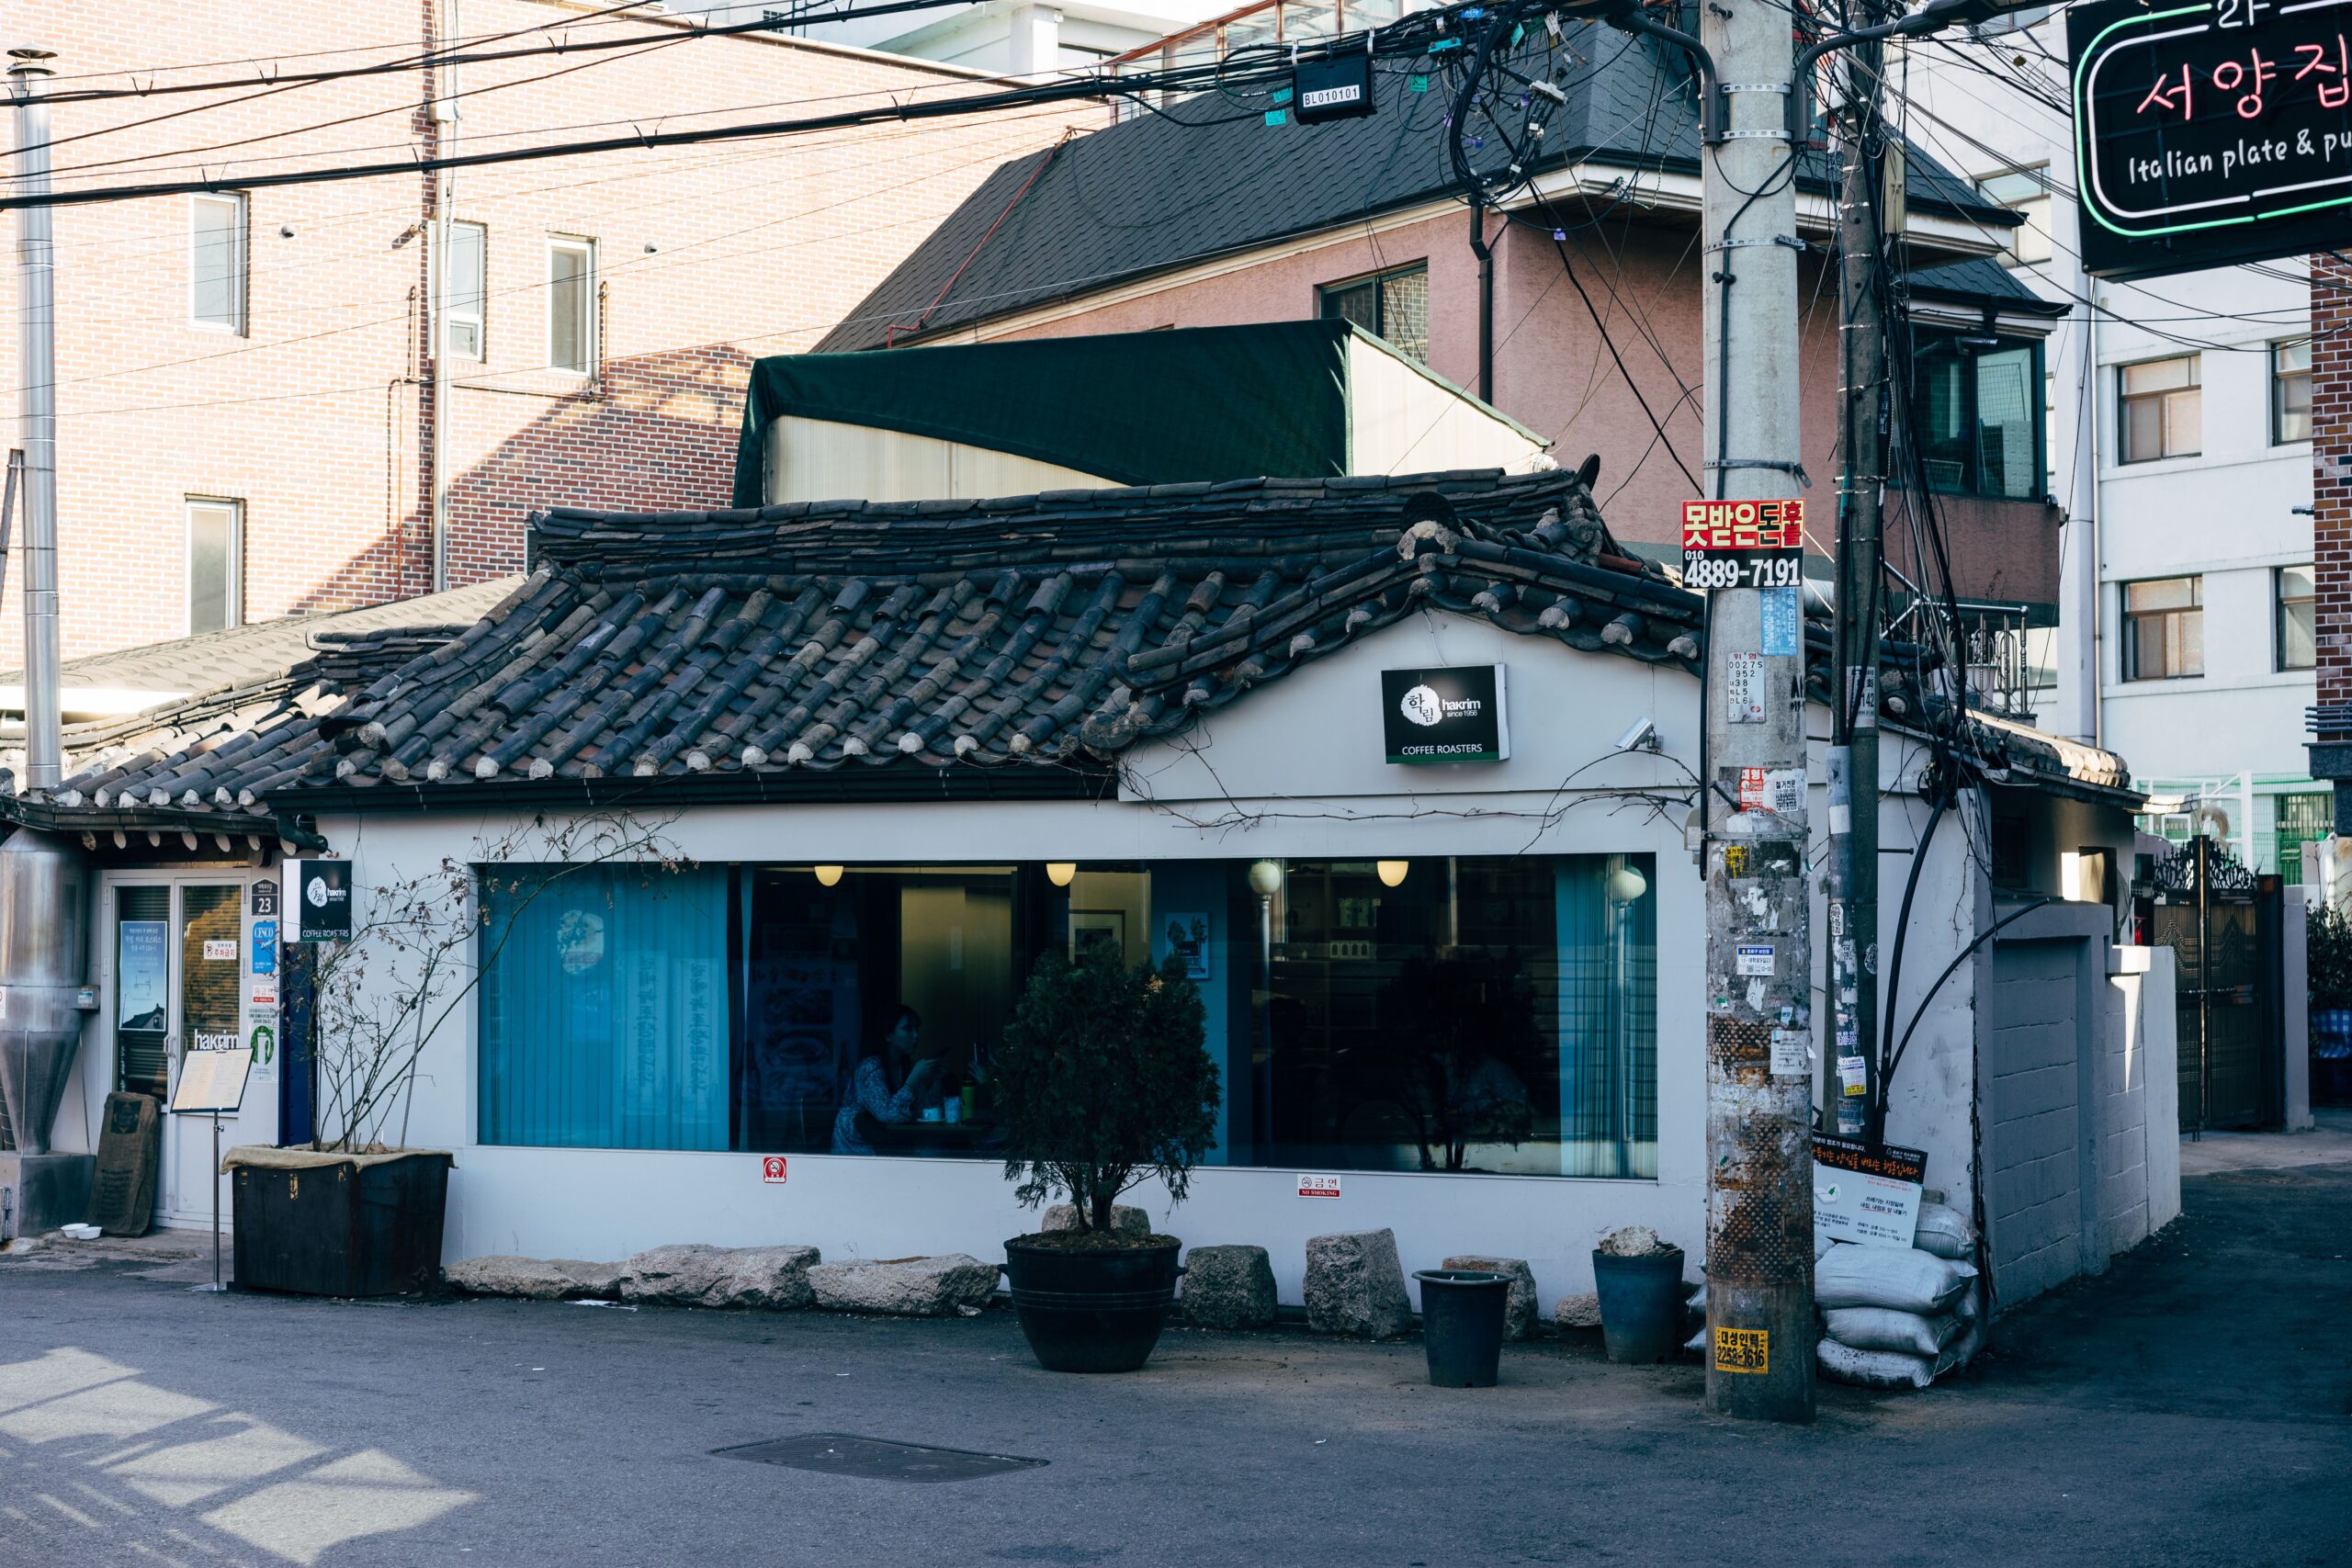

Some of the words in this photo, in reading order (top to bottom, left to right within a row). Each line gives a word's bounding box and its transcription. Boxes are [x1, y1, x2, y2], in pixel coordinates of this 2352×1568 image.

[2136, 33, 2349, 121] 서양집
[1305, 87, 1358, 105] BL010101
[2130, 151, 2212, 184] Italian
[2222, 139, 2288, 179] plate
[2296, 128, 2315, 154] &
[1685, 549, 1704, 560] 010
[1684, 558, 1800, 588] 4889-7191
[1736, 670, 1756, 678] 952
[1408, 694, 1434, 722] 학림
[1442, 698, 1481, 711] hakrim
[1402, 745, 1435, 755] COFFEE
[1437, 743, 1483, 754] ROASTERS
[327, 887, 346, 897] hakrim
[258, 897, 271, 913] 23
[254, 927, 274, 939] CESCO
[302, 930, 322, 938] COFFEE
[323, 929, 349, 937] ROASTERS
[214, 948, 235, 957] 주차금지
[194, 1029, 239, 1051] hakrim
[1314, 1178, 1338, 1189] 금연
[1721, 1331, 1758, 1348] 대성인력
